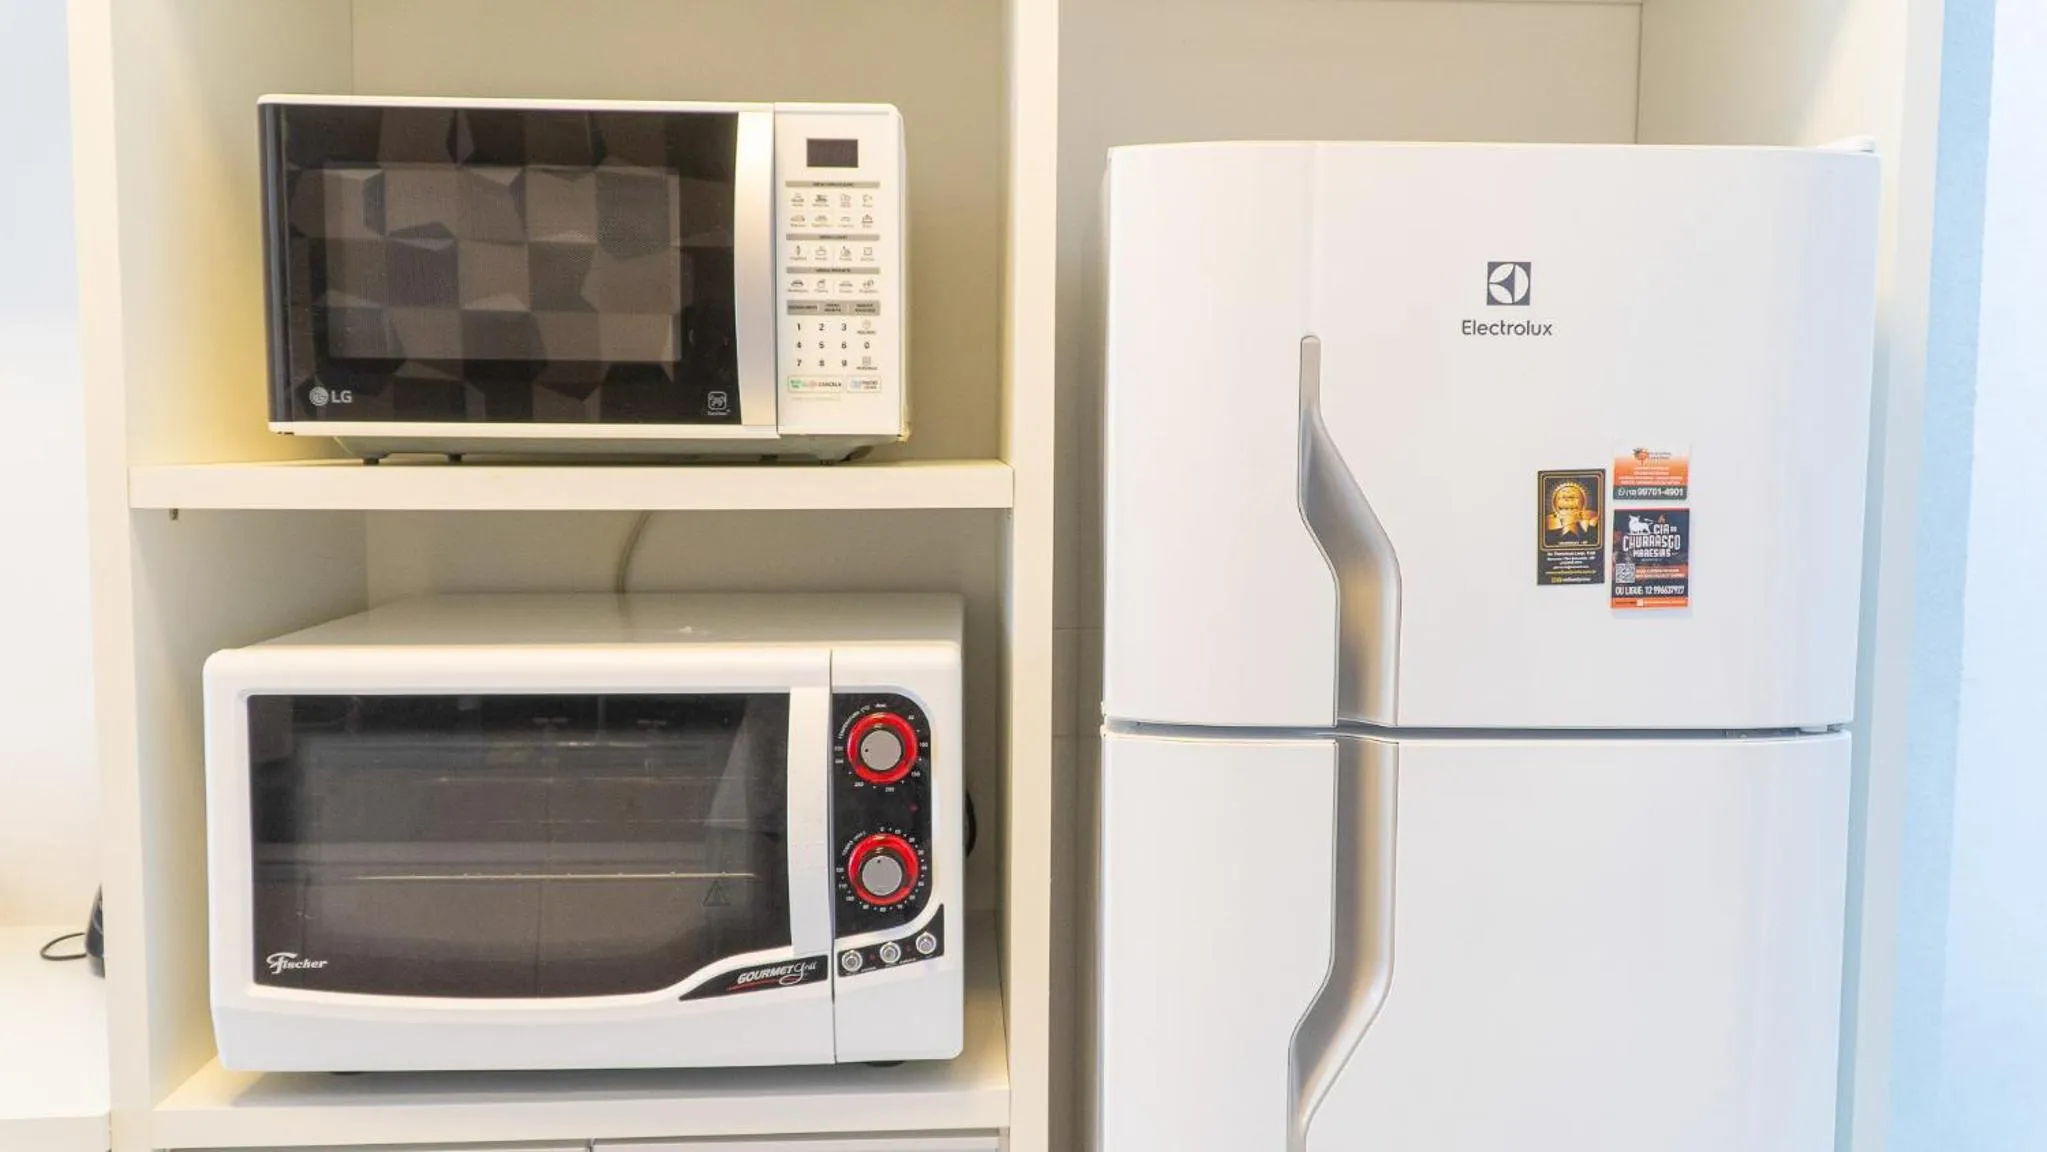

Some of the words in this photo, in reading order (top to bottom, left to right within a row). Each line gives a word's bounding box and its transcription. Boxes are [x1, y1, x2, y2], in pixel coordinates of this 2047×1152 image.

[797, 323, 801, 331] 1
[819, 323, 824, 331] 2
[841, 323, 847, 331] 3
[1462, 320, 1553, 336] Electrolux
[797, 341, 802, 349] 4
[819, 341, 824, 349] 5
[841, 341, 847, 349] 6
[864, 341, 870, 349] 0
[797, 359, 802, 367] 7
[819, 359, 825, 367] 8
[841, 359, 847, 367] 9
[331, 390, 352, 404] LG
[1653, 523, 1670, 535] CIA
[1615, 586, 1624, 595] OU
[1645, 586, 1653, 595] 12
[266, 952, 329, 975] Fischer
[737, 964, 795, 984] GOURMET
